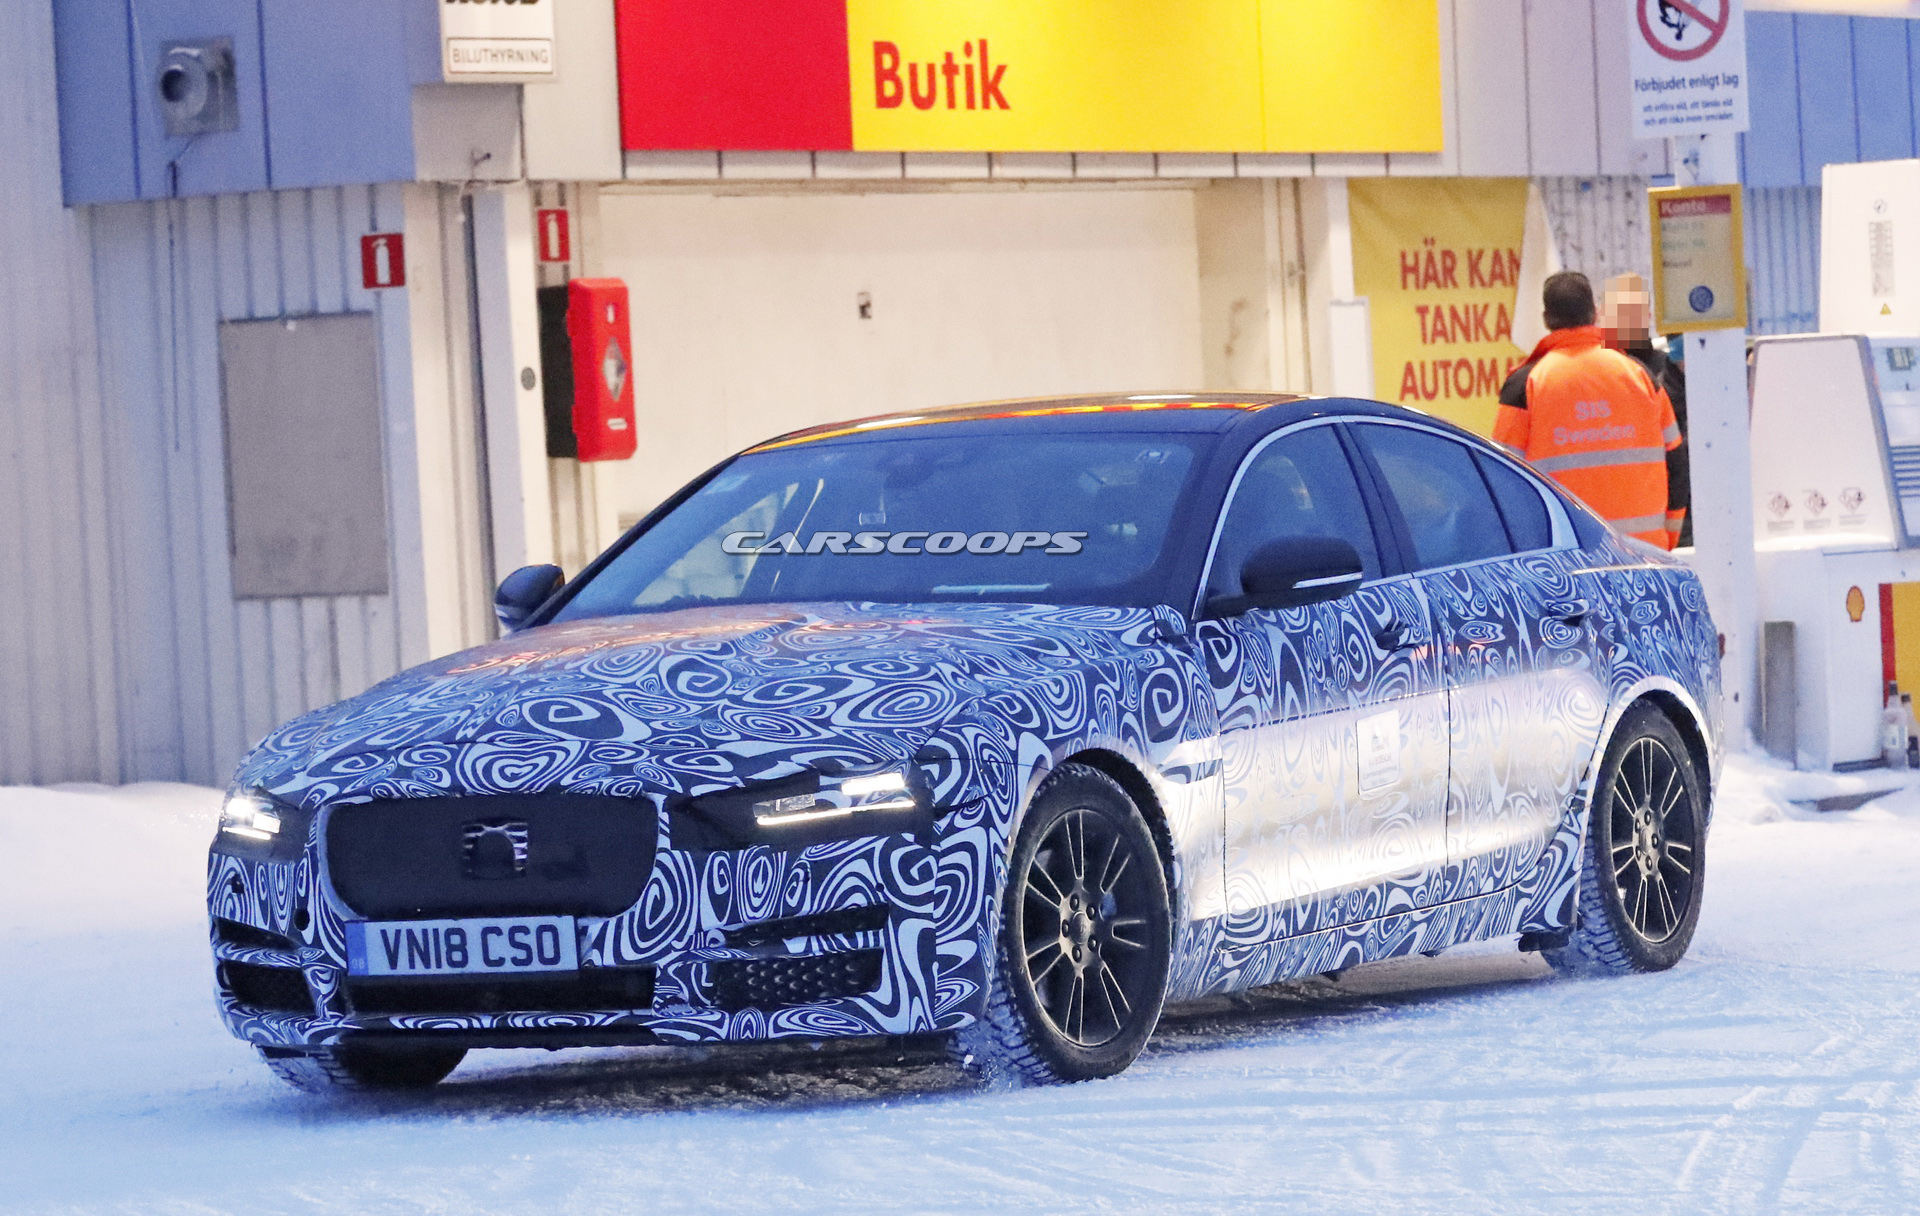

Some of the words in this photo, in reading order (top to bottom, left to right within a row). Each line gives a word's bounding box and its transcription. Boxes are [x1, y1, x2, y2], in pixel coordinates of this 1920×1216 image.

[452, 48, 549, 64] BILUTHYRNING
[873, 38, 1011, 111] Butik
[1688, 73, 1720, 90] enligt
[1721, 72, 1740, 88] lag
[1400, 237, 1458, 290] HÄR
[1467, 248, 1522, 288] KAN
[1415, 303, 1512, 344] TANKA
[1575, 400, 1612, 420] SIS
[1553, 423, 1636, 446] Sweden
[380, 927, 469, 970] VN18
[480, 924, 562, 967] CSO
